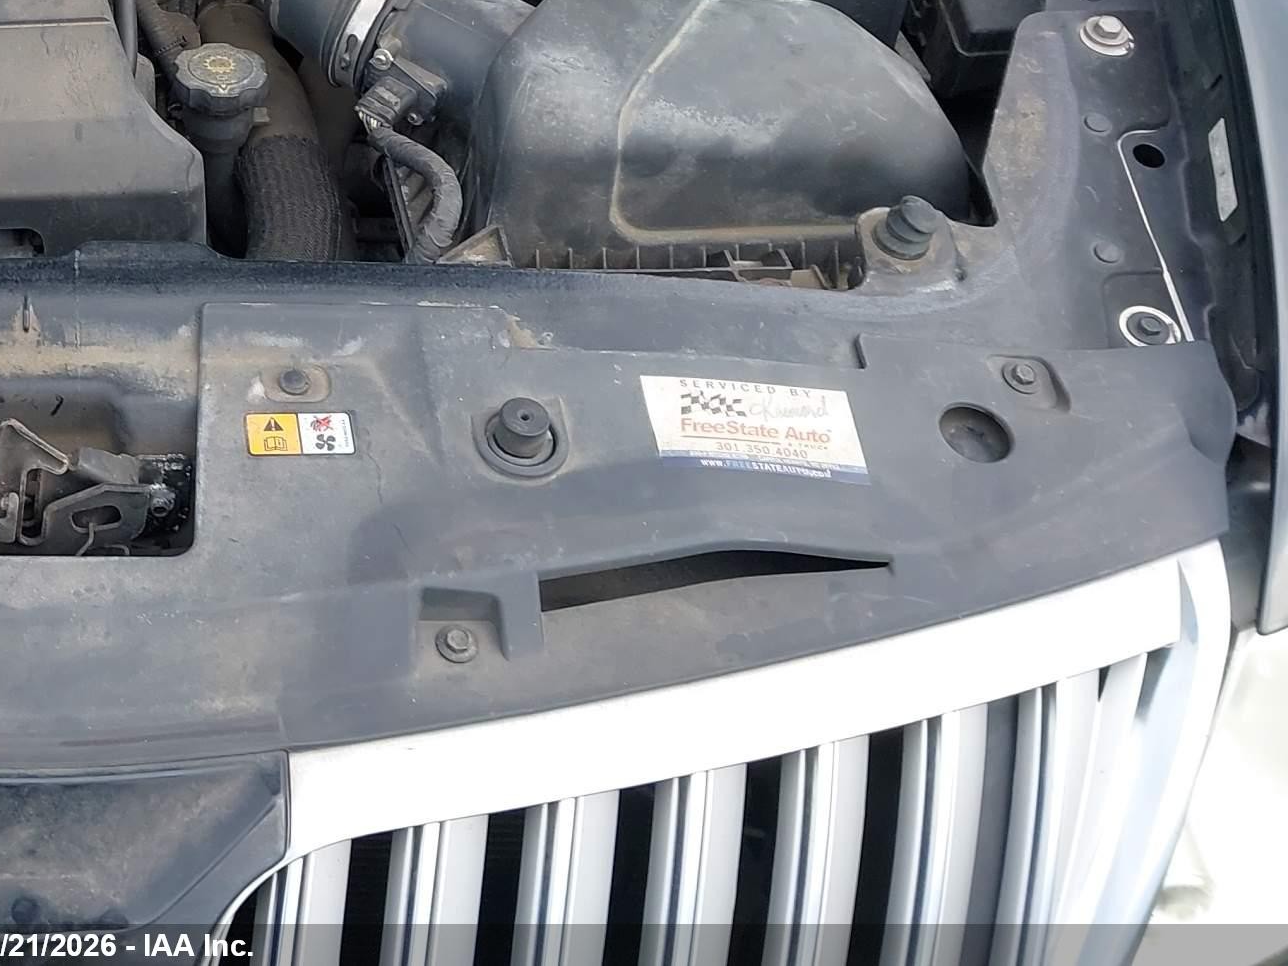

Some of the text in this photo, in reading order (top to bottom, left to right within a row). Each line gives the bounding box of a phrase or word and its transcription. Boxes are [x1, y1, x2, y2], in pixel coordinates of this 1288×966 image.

[679, 379, 812, 399] SERVICED BY
[680, 417, 831, 444] FreeState Auto
[716, 441, 809, 460] 301.350.4040
